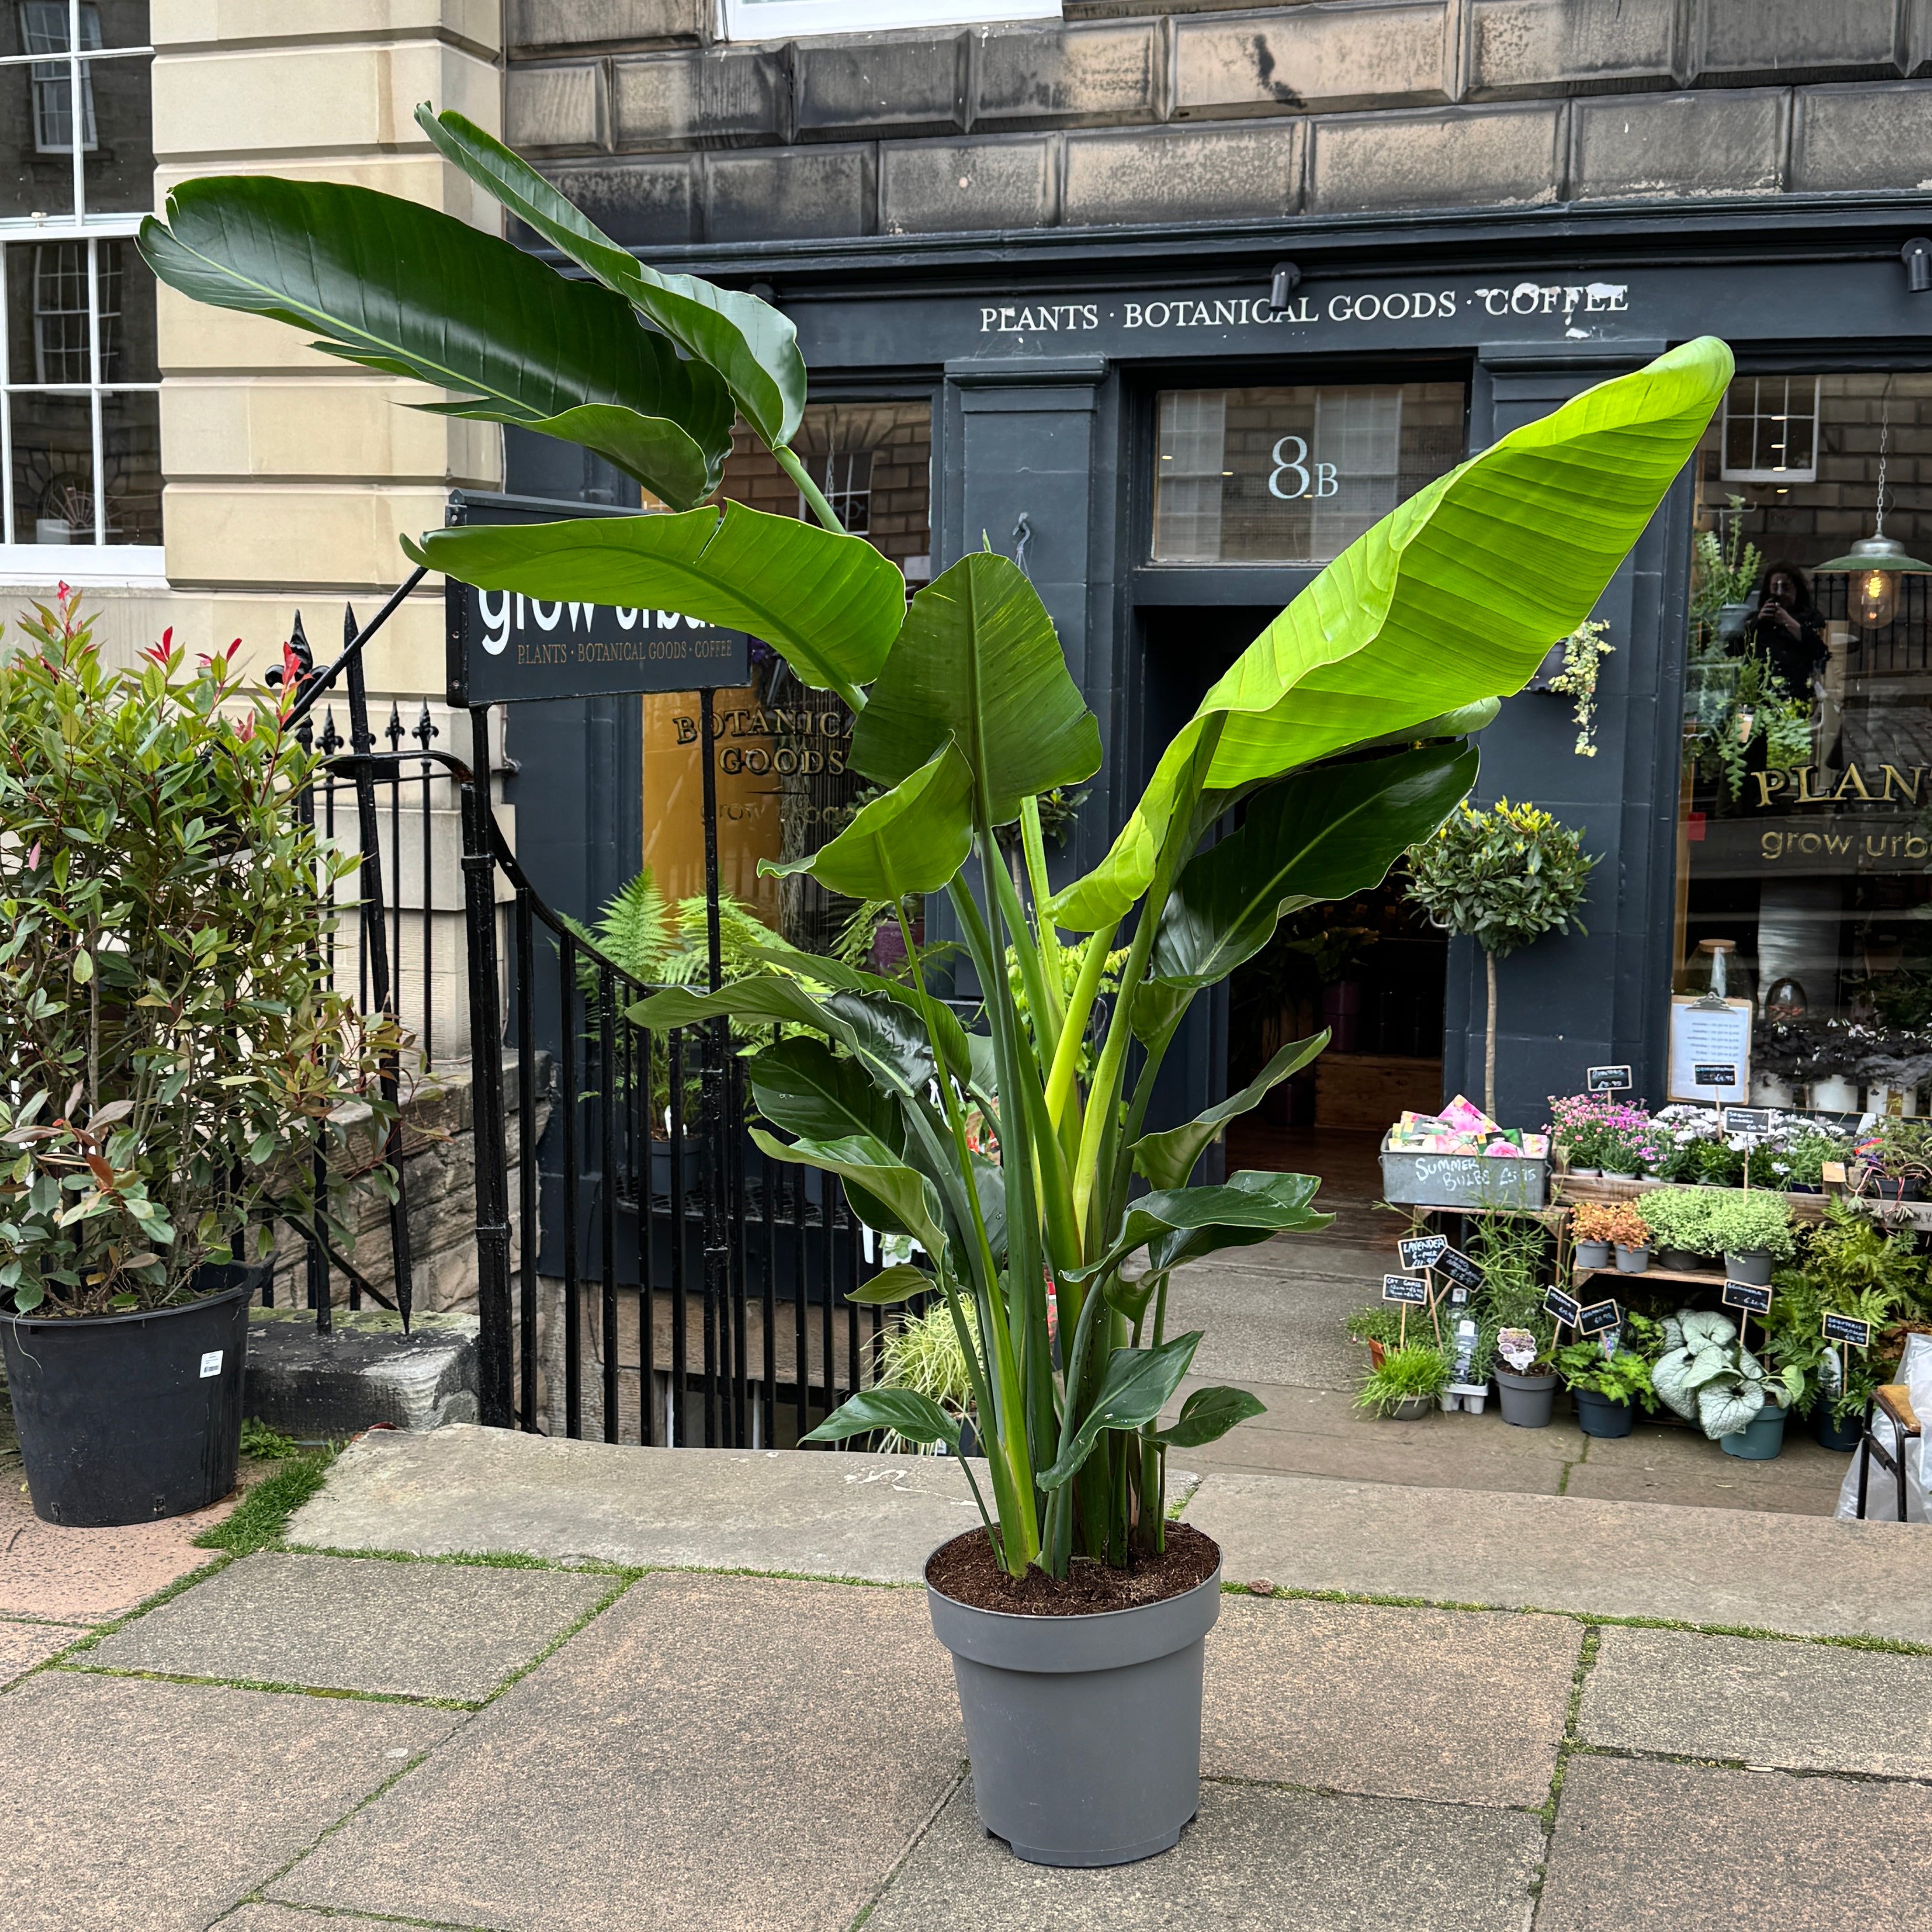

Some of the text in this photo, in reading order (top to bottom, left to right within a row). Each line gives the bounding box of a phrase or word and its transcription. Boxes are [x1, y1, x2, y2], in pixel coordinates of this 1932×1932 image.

[980, 305, 1099, 332] PLANTS
[1328, 290, 1457, 322] GOODS
[1484, 285, 1629, 315] COFFEE
[518, 640, 732, 665] PLANTS BOTANICAL GOODS COFFEE
[673, 709, 854, 744] BOTANIC
[719, 747, 845, 775] GOODS
[1751, 762, 1932, 807] PLAN
[1761, 831, 1932, 859] grow urb
[1416, 1158, 1480, 1182] SUMMER
[1403, 1238, 1445, 1253] LAVENDER
